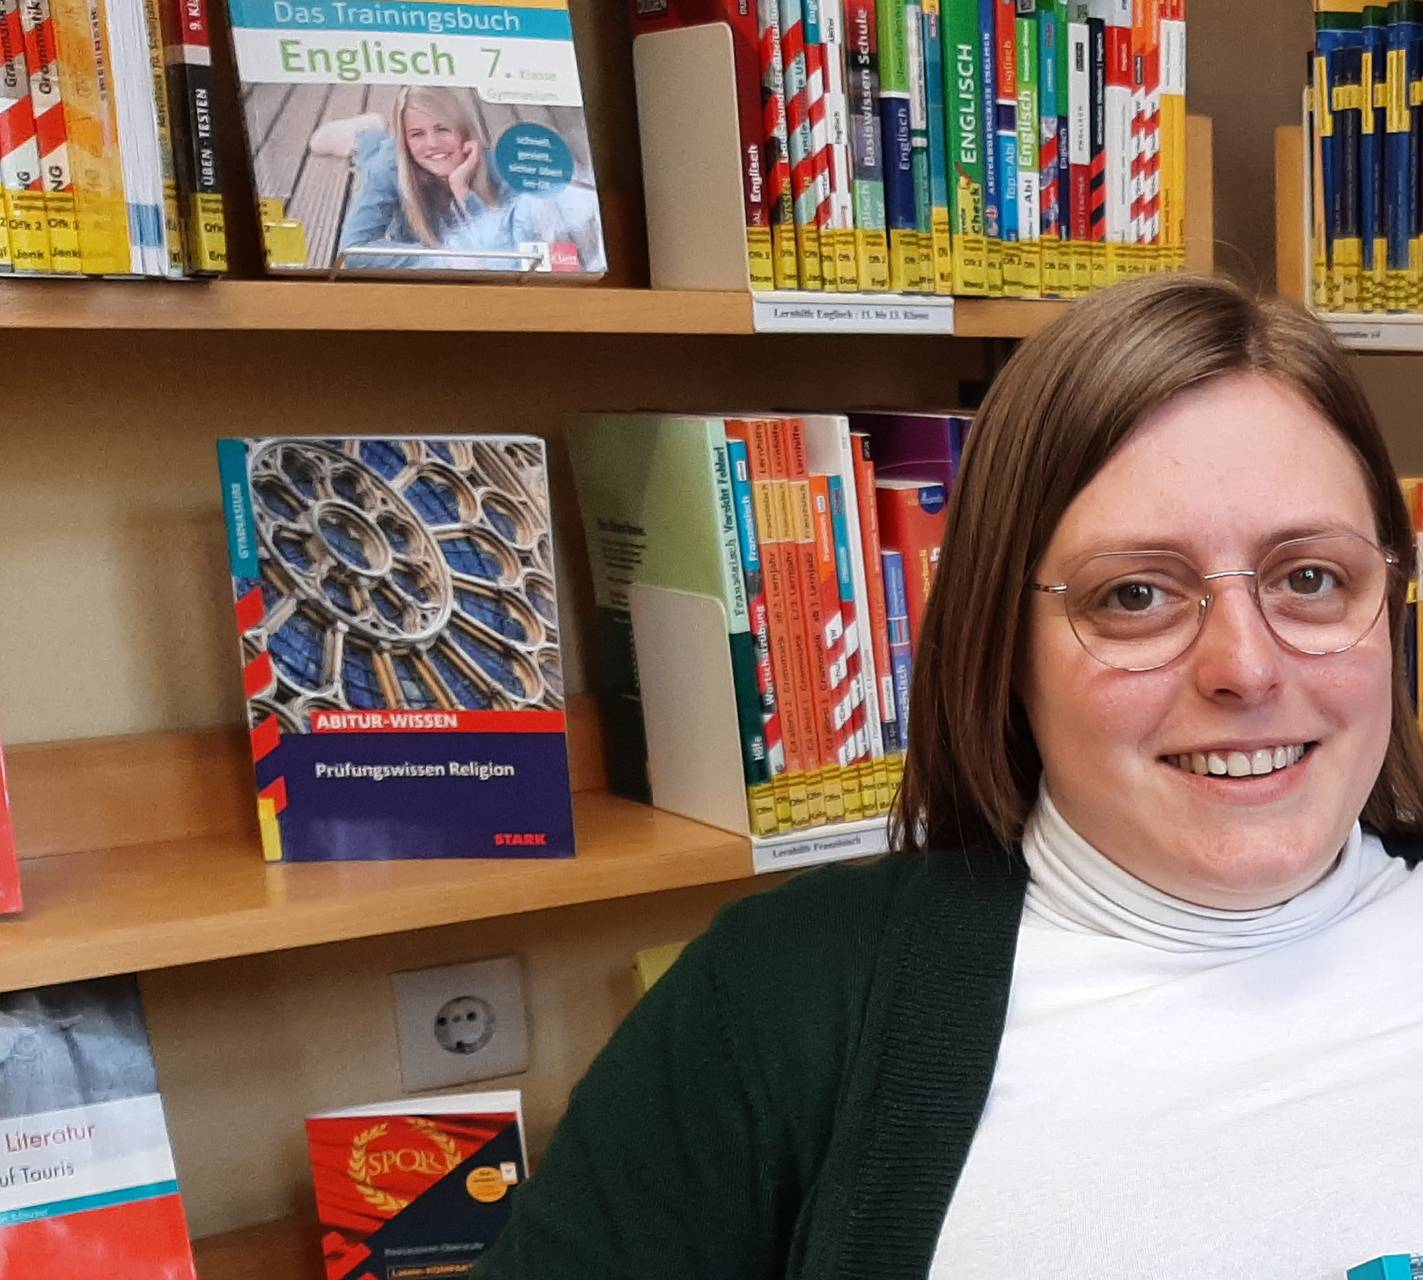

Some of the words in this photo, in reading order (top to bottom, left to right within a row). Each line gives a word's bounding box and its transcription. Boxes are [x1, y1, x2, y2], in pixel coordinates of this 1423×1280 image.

[273, 1, 325, 24] Das
[331, 1, 521, 32] Trainingsbuch
[855, 7, 870, 65] Schule
[279, 39, 455, 82] Englisch
[195, 88, 211, 139] TESTEN
[862, 69, 877, 167] Basiswissen
[956, 44, 978, 164] ENGLISCH
[896, 107, 912, 171] Englisch
[1017, 90, 1033, 167] Englisch
[969, 187, 982, 234] Check
[316, 713, 459, 730] ABITUR-WISSEN
[315, 760, 446, 781] Prüfungswissen
[448, 761, 515, 781] Religion
[493, 832, 547, 846] STARK
[5, 1123, 96, 1153] Literatur
[20, 1160, 74, 1184] Tauris
[367, 1148, 443, 1177] SPQR
